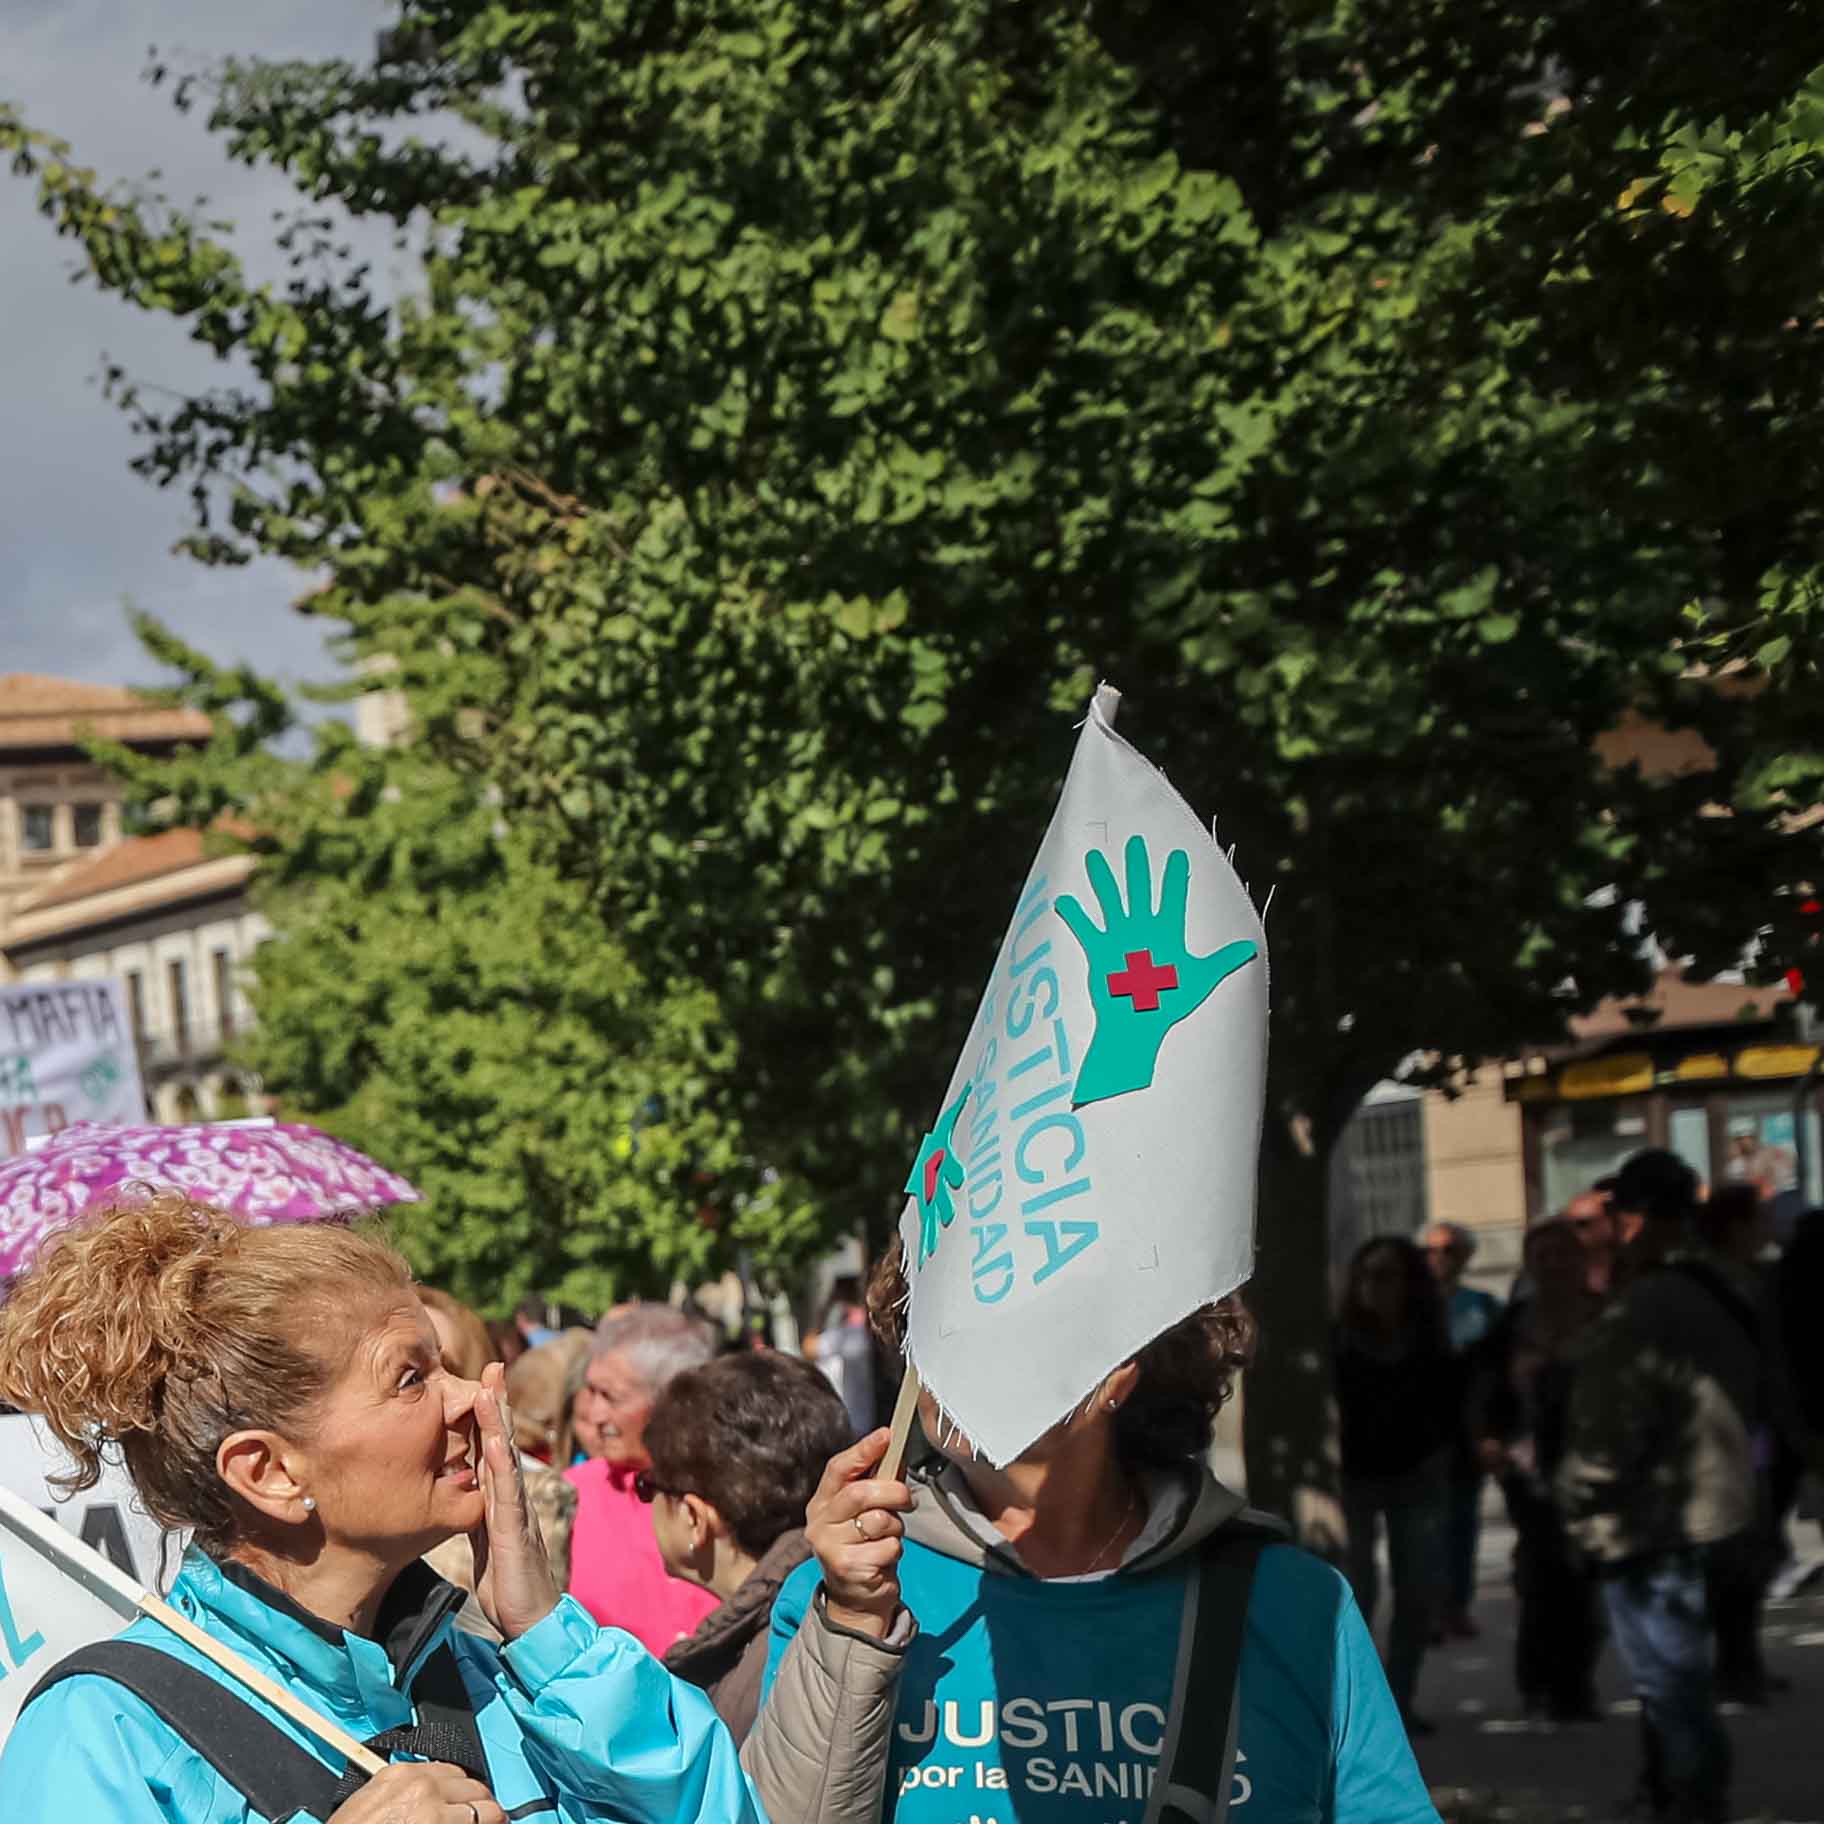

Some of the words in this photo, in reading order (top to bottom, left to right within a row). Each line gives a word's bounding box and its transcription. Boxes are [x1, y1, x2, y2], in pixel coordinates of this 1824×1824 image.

[2, 986, 120, 1052] MAFIA
[1007, 876, 1100, 1287] JUSTICIA
[968, 1039, 1016, 1305] SANIDAD
[898, 1697, 1167, 1756] JUSTIC
[898, 1762, 964, 1797] por
[975, 1761, 1009, 1789] la
